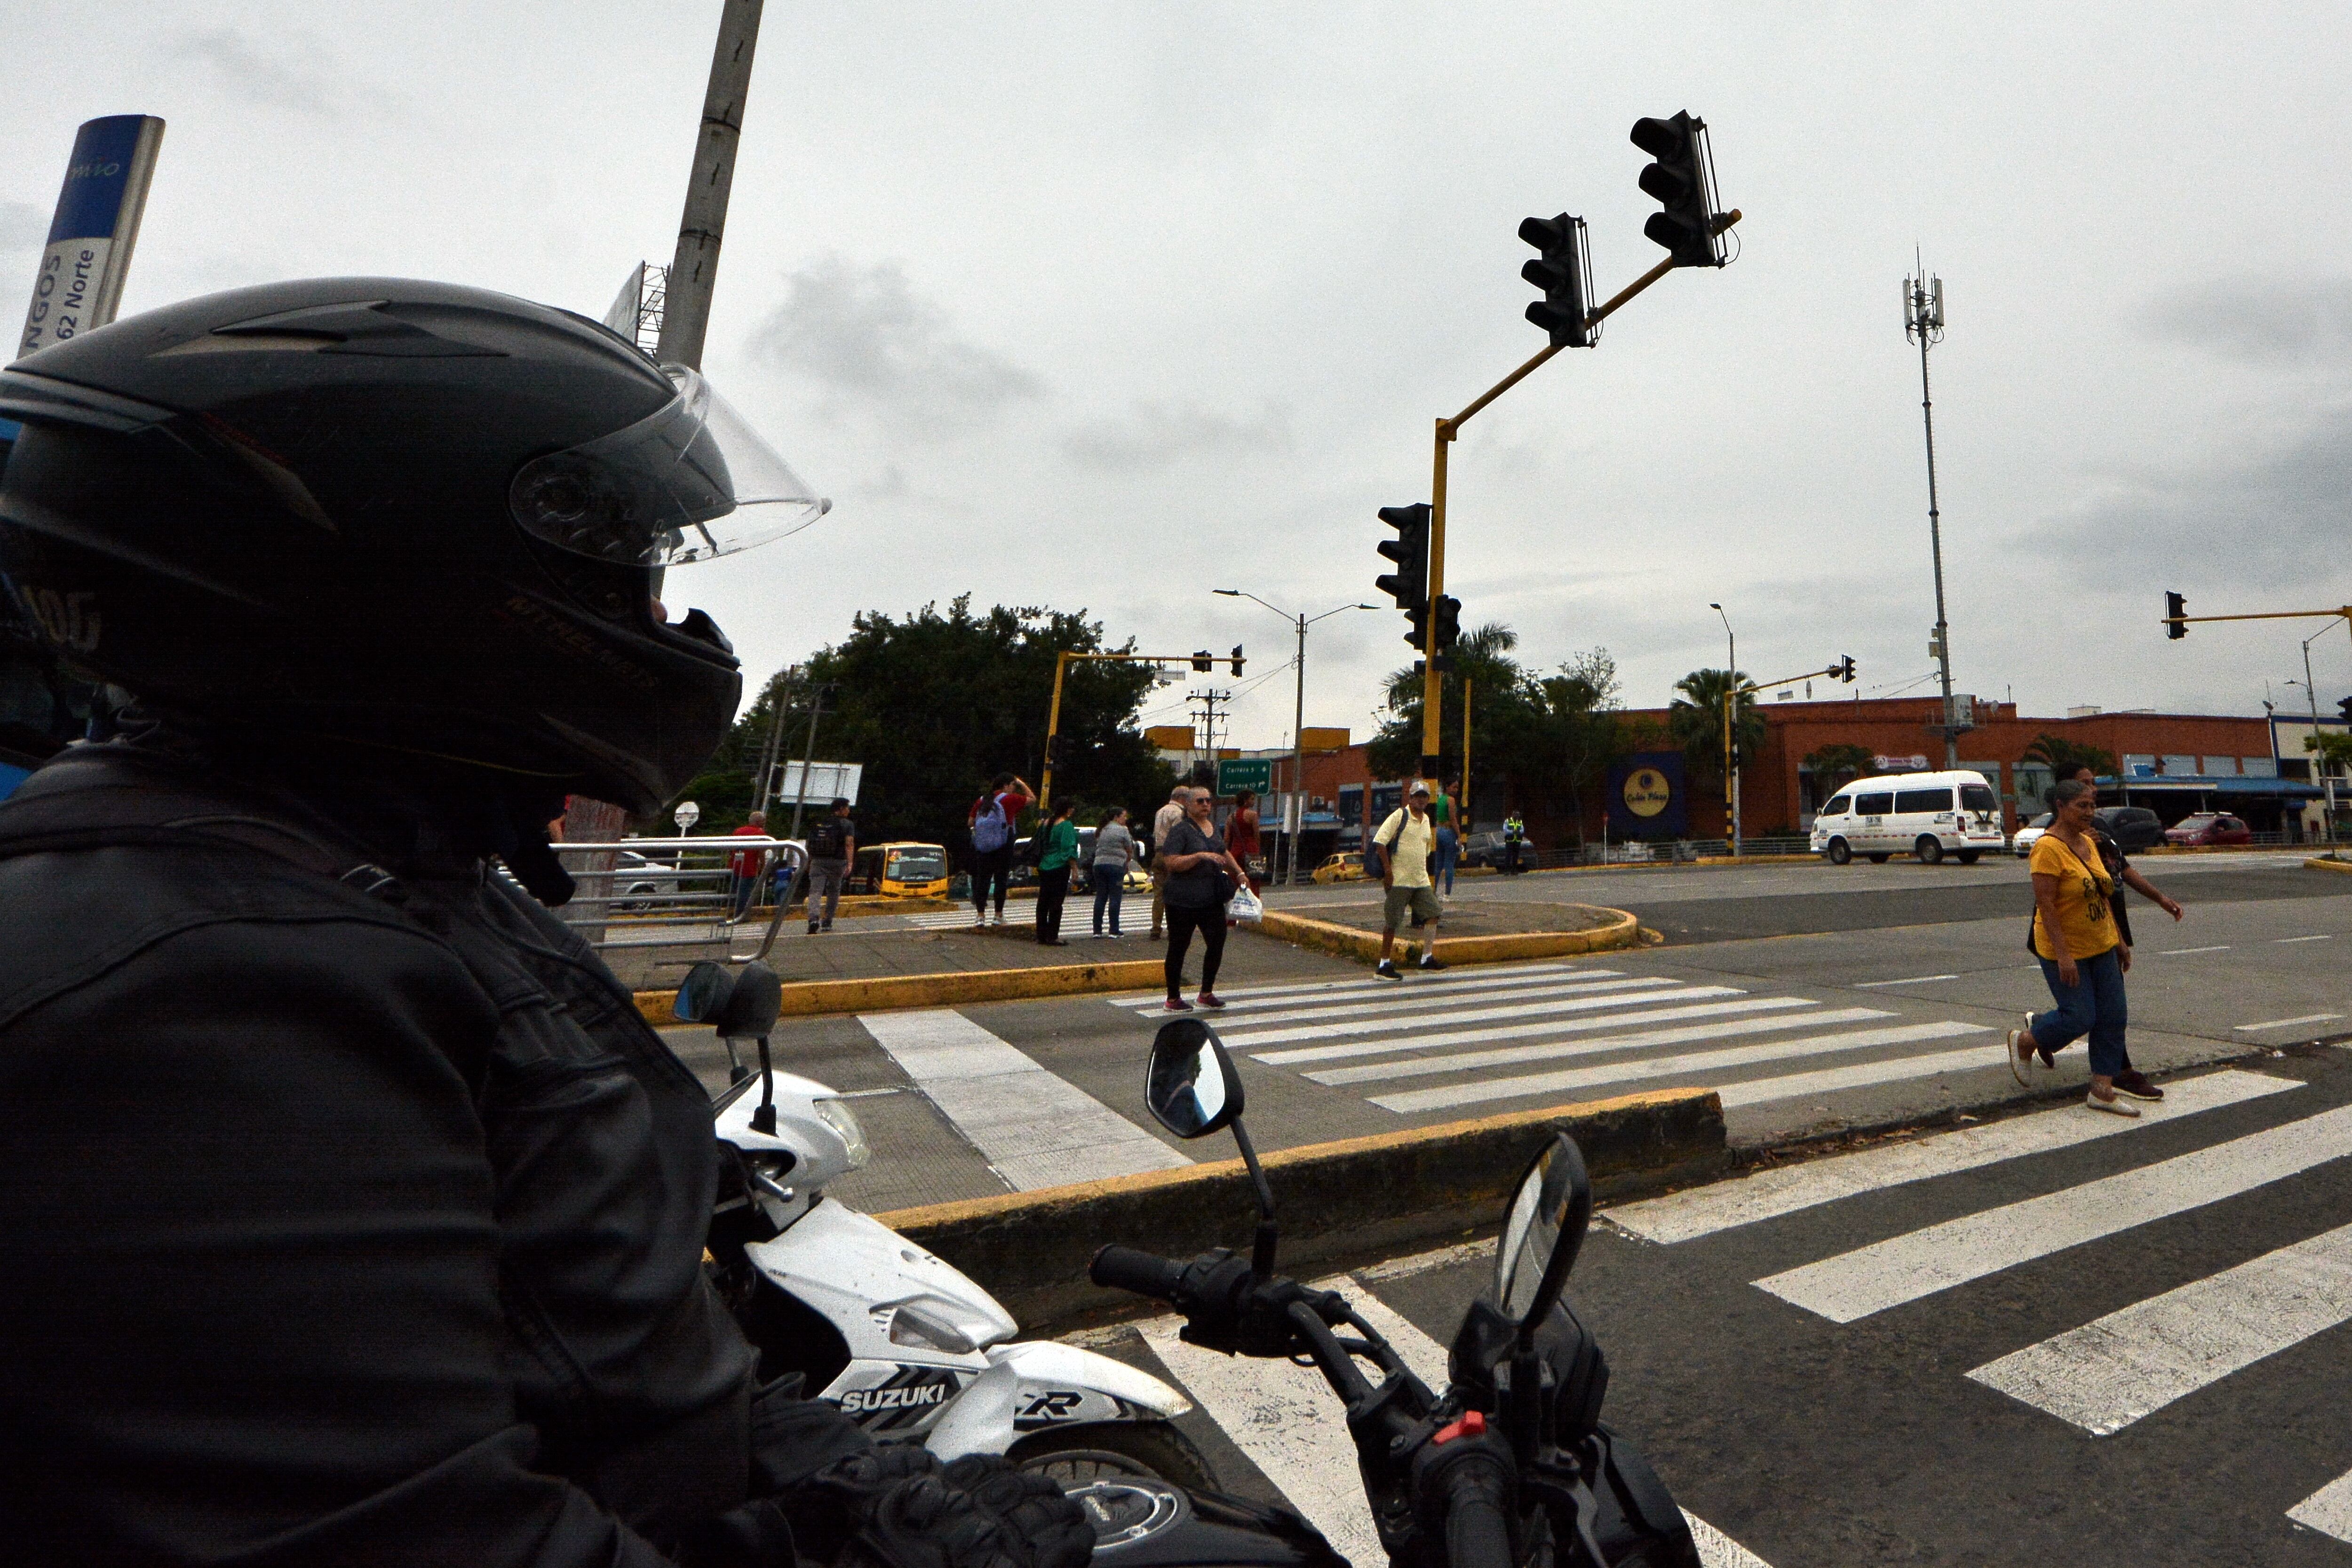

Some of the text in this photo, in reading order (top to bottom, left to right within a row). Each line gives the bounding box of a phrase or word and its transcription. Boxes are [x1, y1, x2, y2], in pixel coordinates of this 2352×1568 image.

[57, 249, 94, 340] 62 Norte
[841, 1384, 947, 1413] SUZUKI
